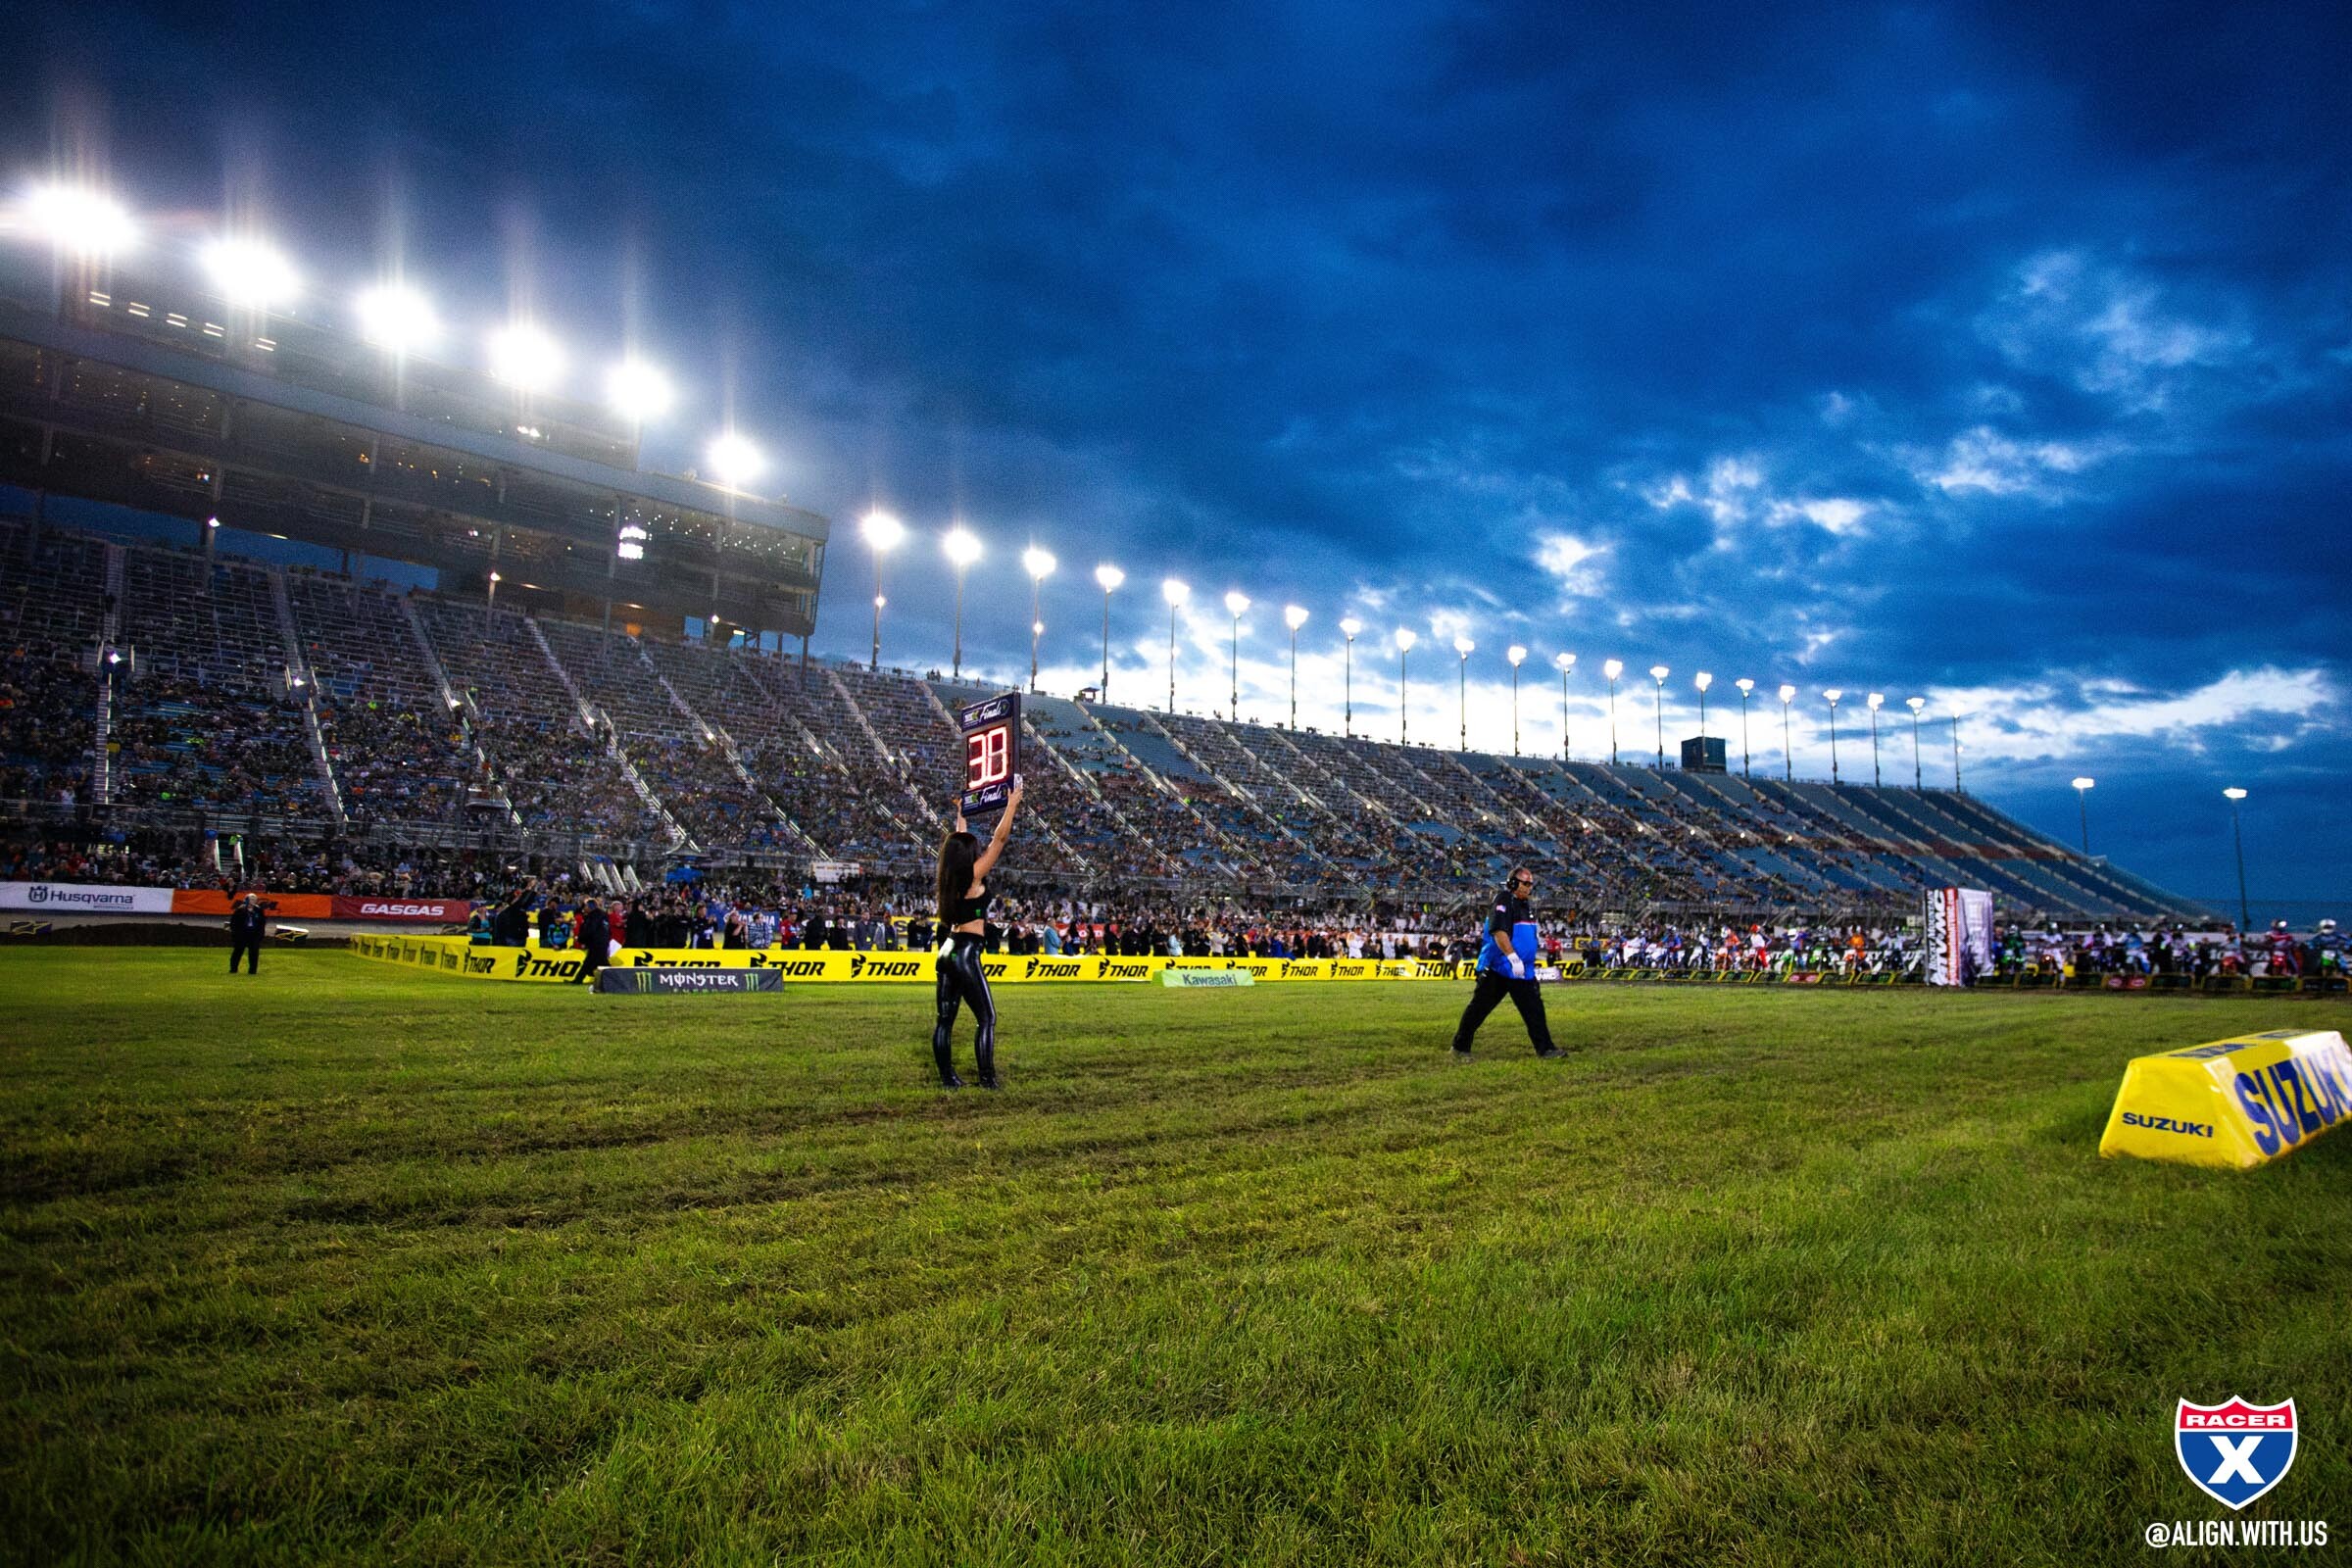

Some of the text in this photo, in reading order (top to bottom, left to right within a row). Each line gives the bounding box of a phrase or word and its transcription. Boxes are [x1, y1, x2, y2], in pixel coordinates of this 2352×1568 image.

[50, 890, 133, 904] Husqvarna
[361, 904, 445, 915] GASGAS
[470, 956, 496, 973] THOR
[530, 959, 581, 977] THO
[867, 961, 920, 976] THOR
[983, 964, 1007, 976] OR
[1038, 964, 1081, 977] THOR
[1109, 964, 1149, 977] THOR
[1289, 966, 1318, 977] THOR
[1339, 966, 1364, 977] THOR
[1416, 962, 1452, 977] THOR
[660, 972, 739, 987] MONSTER
[1183, 974, 1238, 986] Kawasaki
[2234, 1046, 2352, 1157] SUZUK
[2122, 1111, 2214, 1138] SUZUKI
